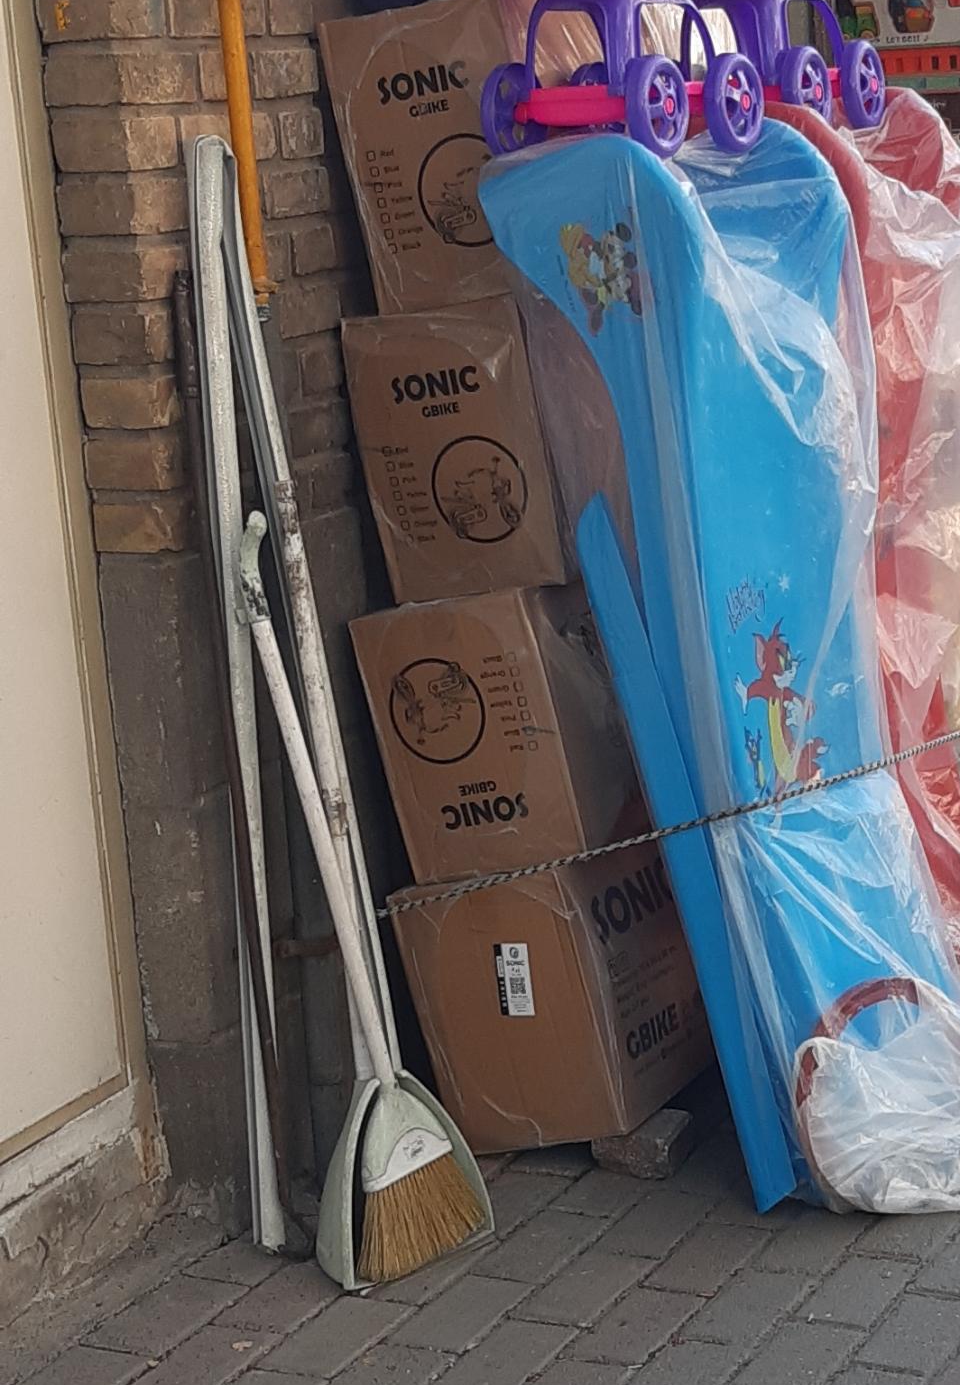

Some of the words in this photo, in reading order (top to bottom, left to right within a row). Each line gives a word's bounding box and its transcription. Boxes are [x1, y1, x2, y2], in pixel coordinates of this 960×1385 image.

[377, 60, 470, 105] SONIC
[391, 365, 480, 405] SONIC
[422, 402, 460, 418] GBIKE
[458, 780, 497, 797] GBIKE
[441, 792, 529, 831] SONIC
[626, 1003, 680, 1060] GBIKE
